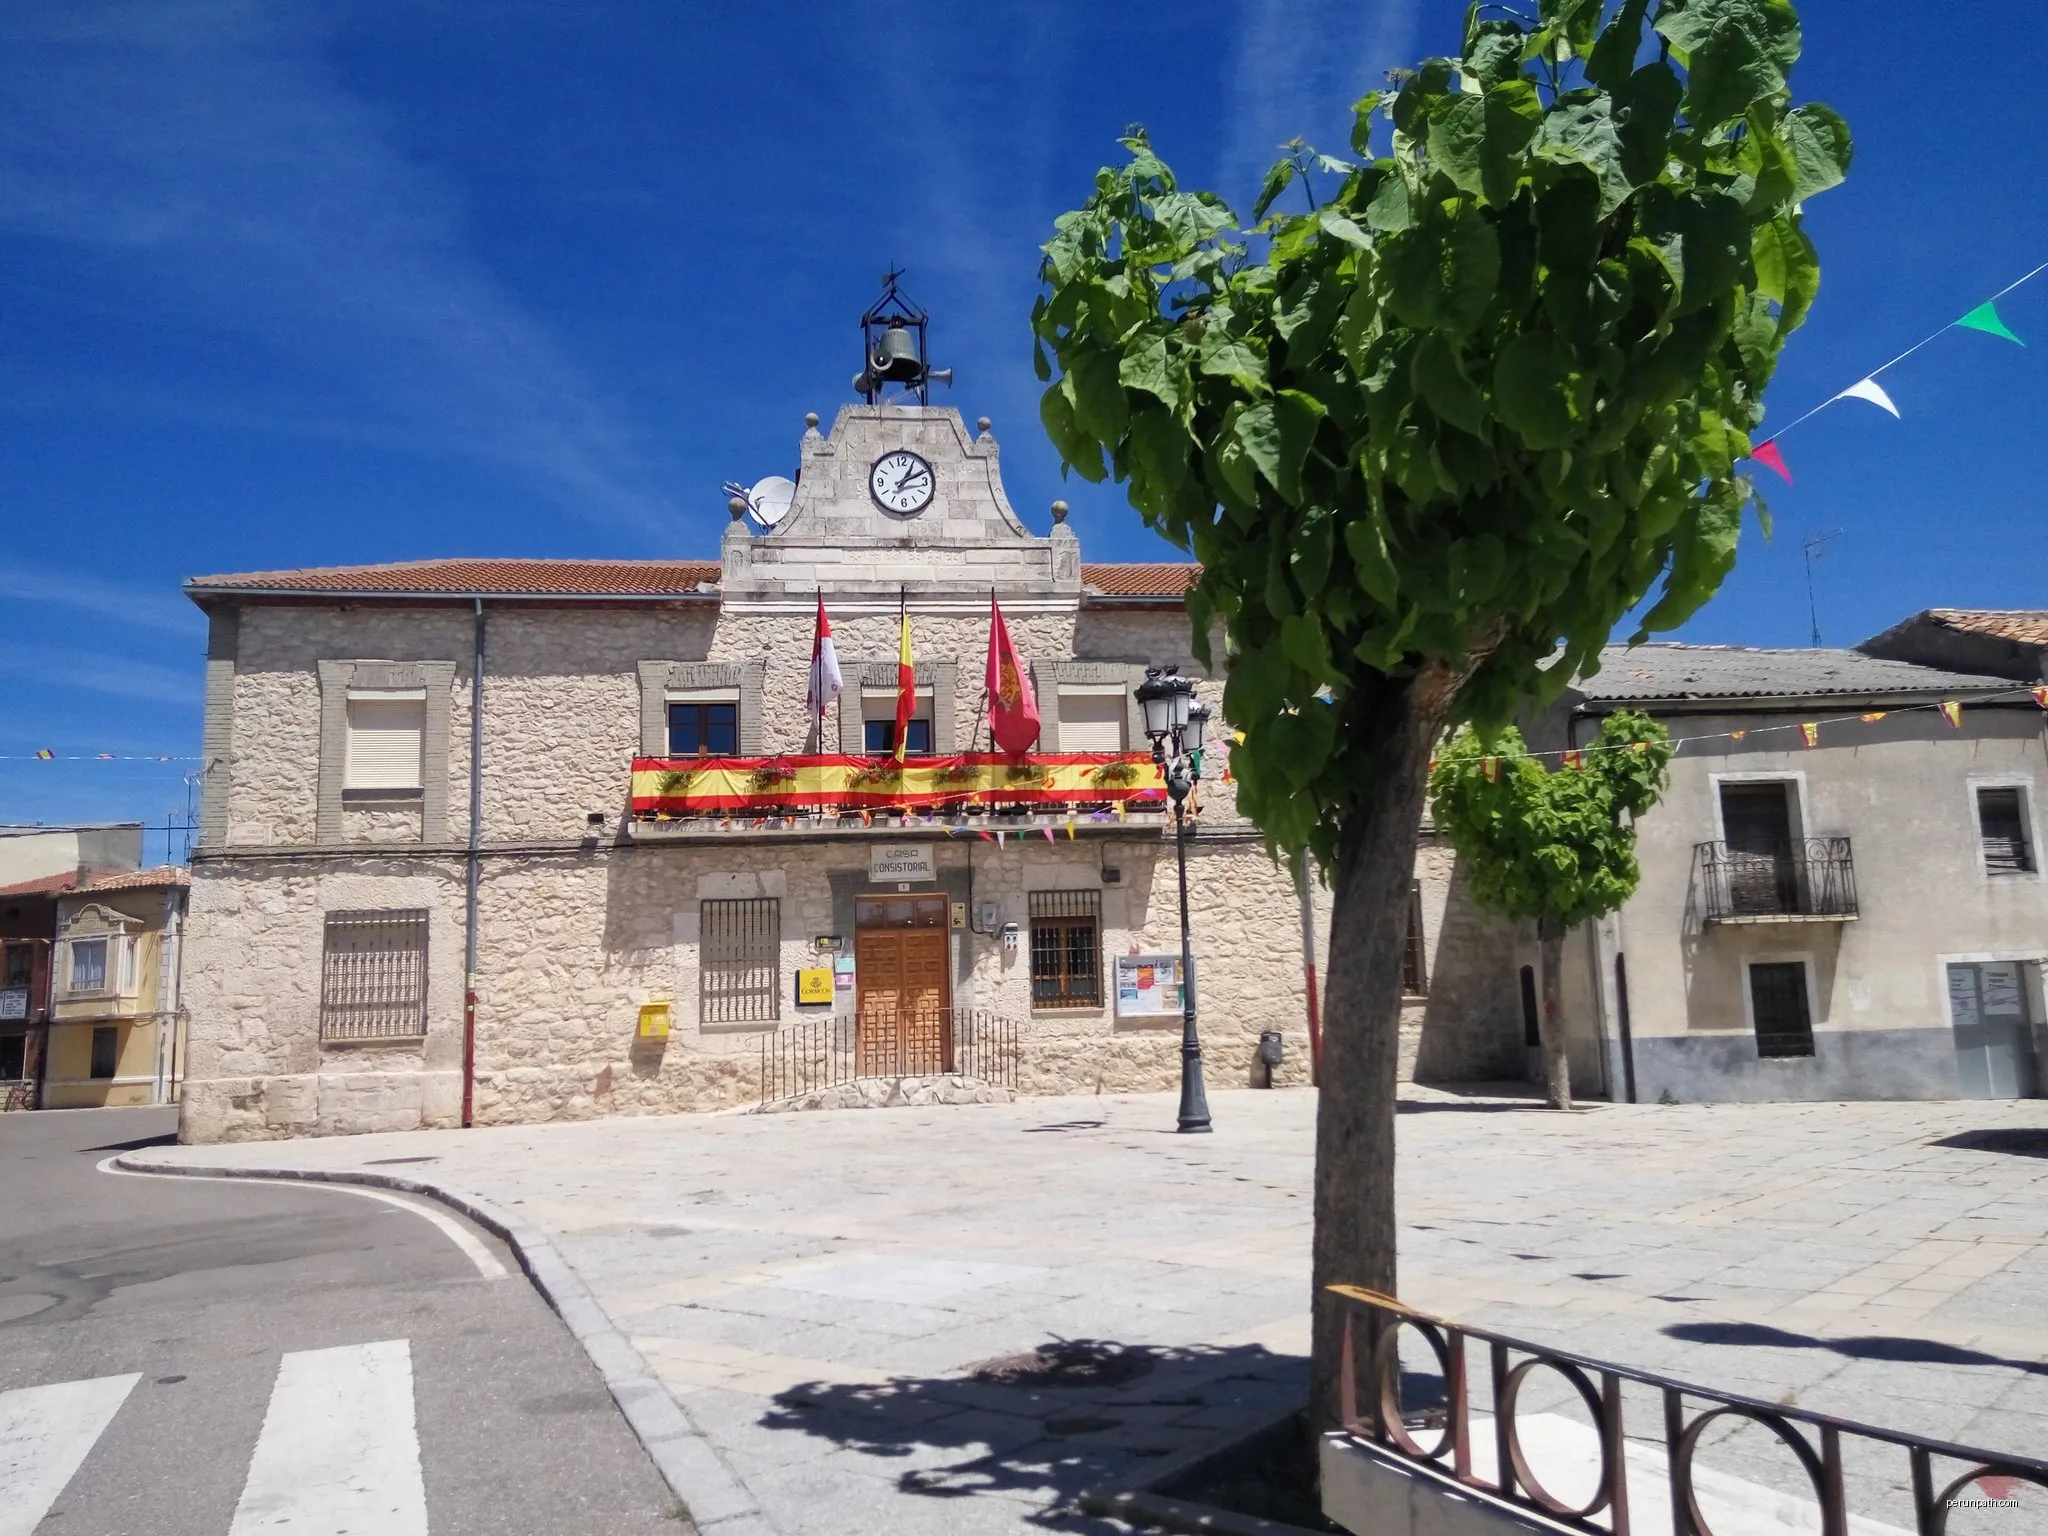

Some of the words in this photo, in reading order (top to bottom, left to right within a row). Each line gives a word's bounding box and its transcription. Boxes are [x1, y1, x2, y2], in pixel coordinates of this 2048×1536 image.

[896, 456, 908, 467] 12
[876, 477, 884, 488] 9
[921, 476, 929, 487] 3
[900, 497, 908, 508] 6
[885, 849, 919, 859] CASA
[873, 861, 932, 873] CONSISTORIAL
